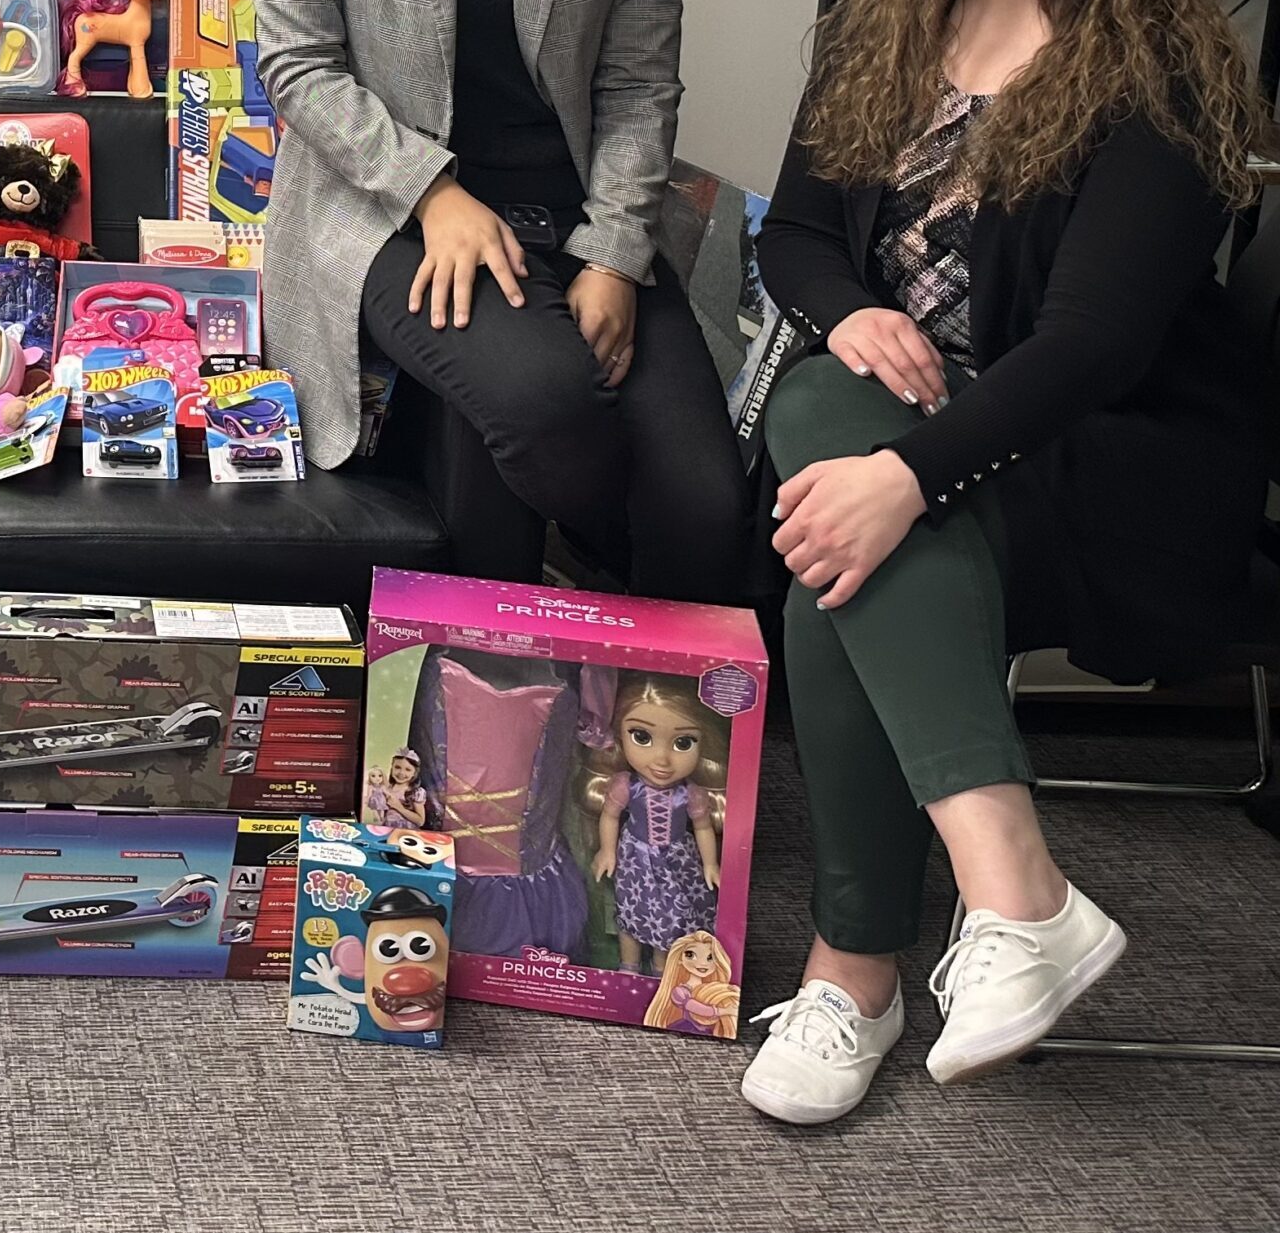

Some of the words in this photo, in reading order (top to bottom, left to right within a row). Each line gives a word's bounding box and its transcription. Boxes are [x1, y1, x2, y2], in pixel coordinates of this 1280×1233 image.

[182, 100, 210, 155] SERIES
[182, 149, 210, 222] SPRINTE
[210, 310, 236, 319] 12:45
[91, 373, 123, 392] HOT
[744, 319, 794, 429] MORSHIELD
[208, 375, 241, 397] HOT
[530, 596, 600, 614] Disney
[497, 603, 636, 629] PRINCESS
[375, 621, 423, 641] Rapunzel
[253, 654, 301, 663] SPECIAL
[303, 655, 350, 665] EDITION
[32, 731, 120, 750] Razor
[269, 784, 293, 792] ages
[295, 780, 317, 794] 5+
[251, 823, 299, 833] SPECIAL
[306, 869, 365, 894] Potato
[313, 888, 362, 912] Head
[49, 904, 110, 919] Razor
[311, 919, 328, 932] 13
[526, 948, 569, 967] Disney
[502, 961, 587, 983] PRINCESS
[821, 990, 844, 1010] Keds
[310, 1004, 333, 1014] Potato
[334, 1007, 352, 1017] Head
